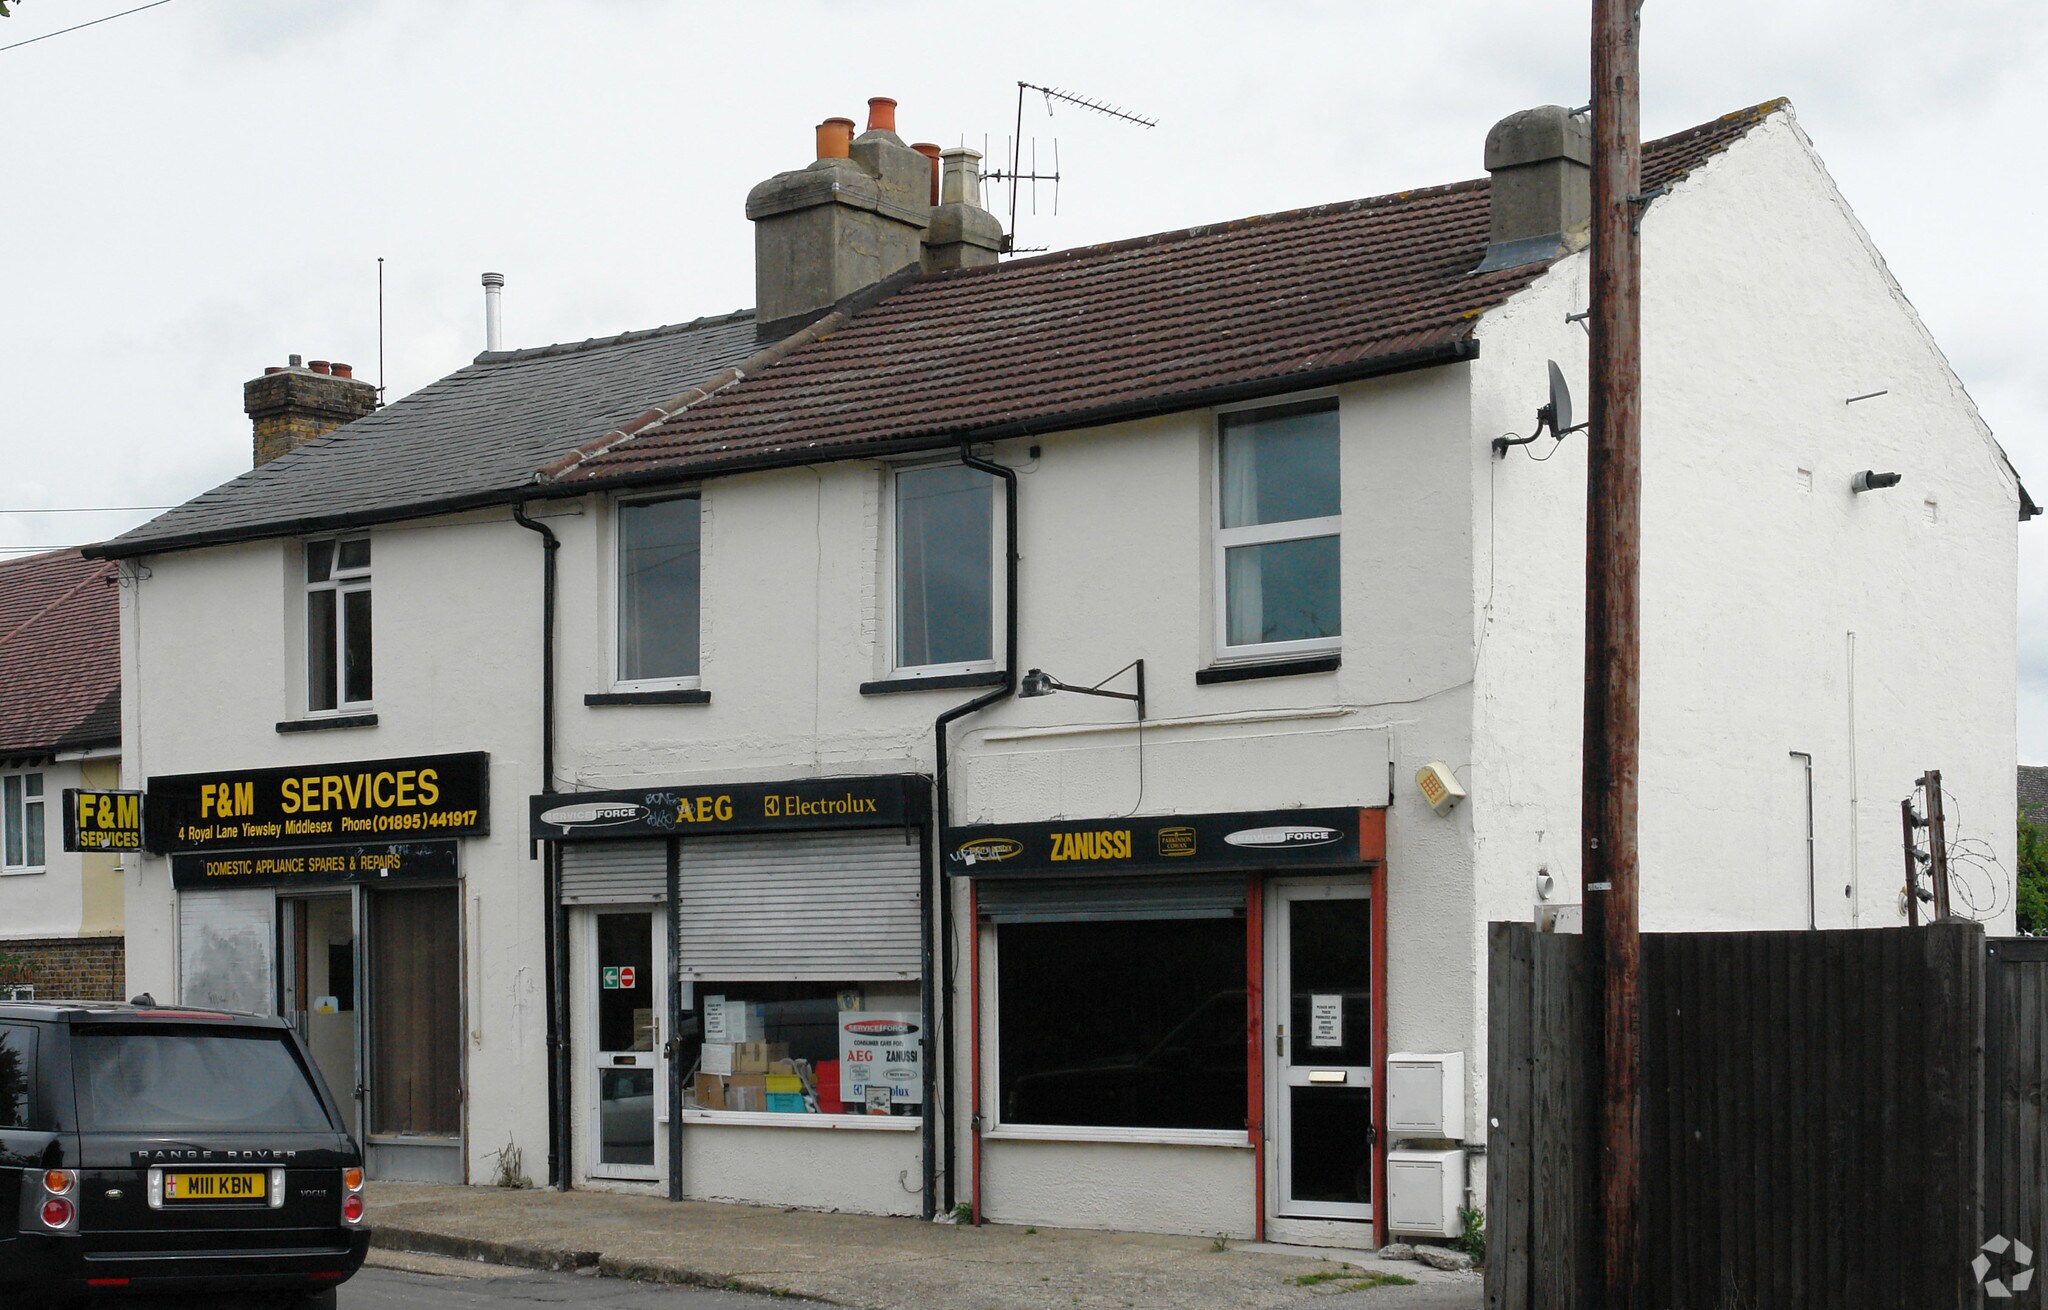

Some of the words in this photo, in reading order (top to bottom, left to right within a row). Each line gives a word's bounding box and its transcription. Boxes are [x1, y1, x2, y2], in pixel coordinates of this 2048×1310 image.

[201, 782, 254, 818] F&M
[281, 768, 439, 813] SERVICES
[79, 793, 139, 829] F&M
[597, 808, 636, 818] FORCE
[675, 795, 733, 823] AEG
[785, 793, 877, 815] Electrolux
[80, 831, 139, 847] SERVICES
[178, 826, 185, 840] 4
[188, 825, 213, 842] Royal
[216, 824, 238, 839] Lane
[242, 821, 281, 838] Yiewsley
[285, 819, 333, 835] Middlesex
[341, 816, 372, 832] Phone
[1286, 831, 1329, 841] FORCE
[1050, 830, 1132, 861] ZANUSSI
[206, 860, 252, 876] DOMESTIC
[255, 858, 305, 874] APPLIANCE
[308, 855, 345, 872] SPARES
[349, 856, 356, 871] &
[360, 853, 401, 870] REPAIRS
[848, 1024, 879, 1032] SERVICE
[847, 1050, 873, 1062] AEG
[886, 1050, 918, 1063] ZANUSSI
[138, 1150, 212, 1159] RANGE
[228, 1150, 297, 1159] ROVER
[219, 1176, 253, 1194] KBN
